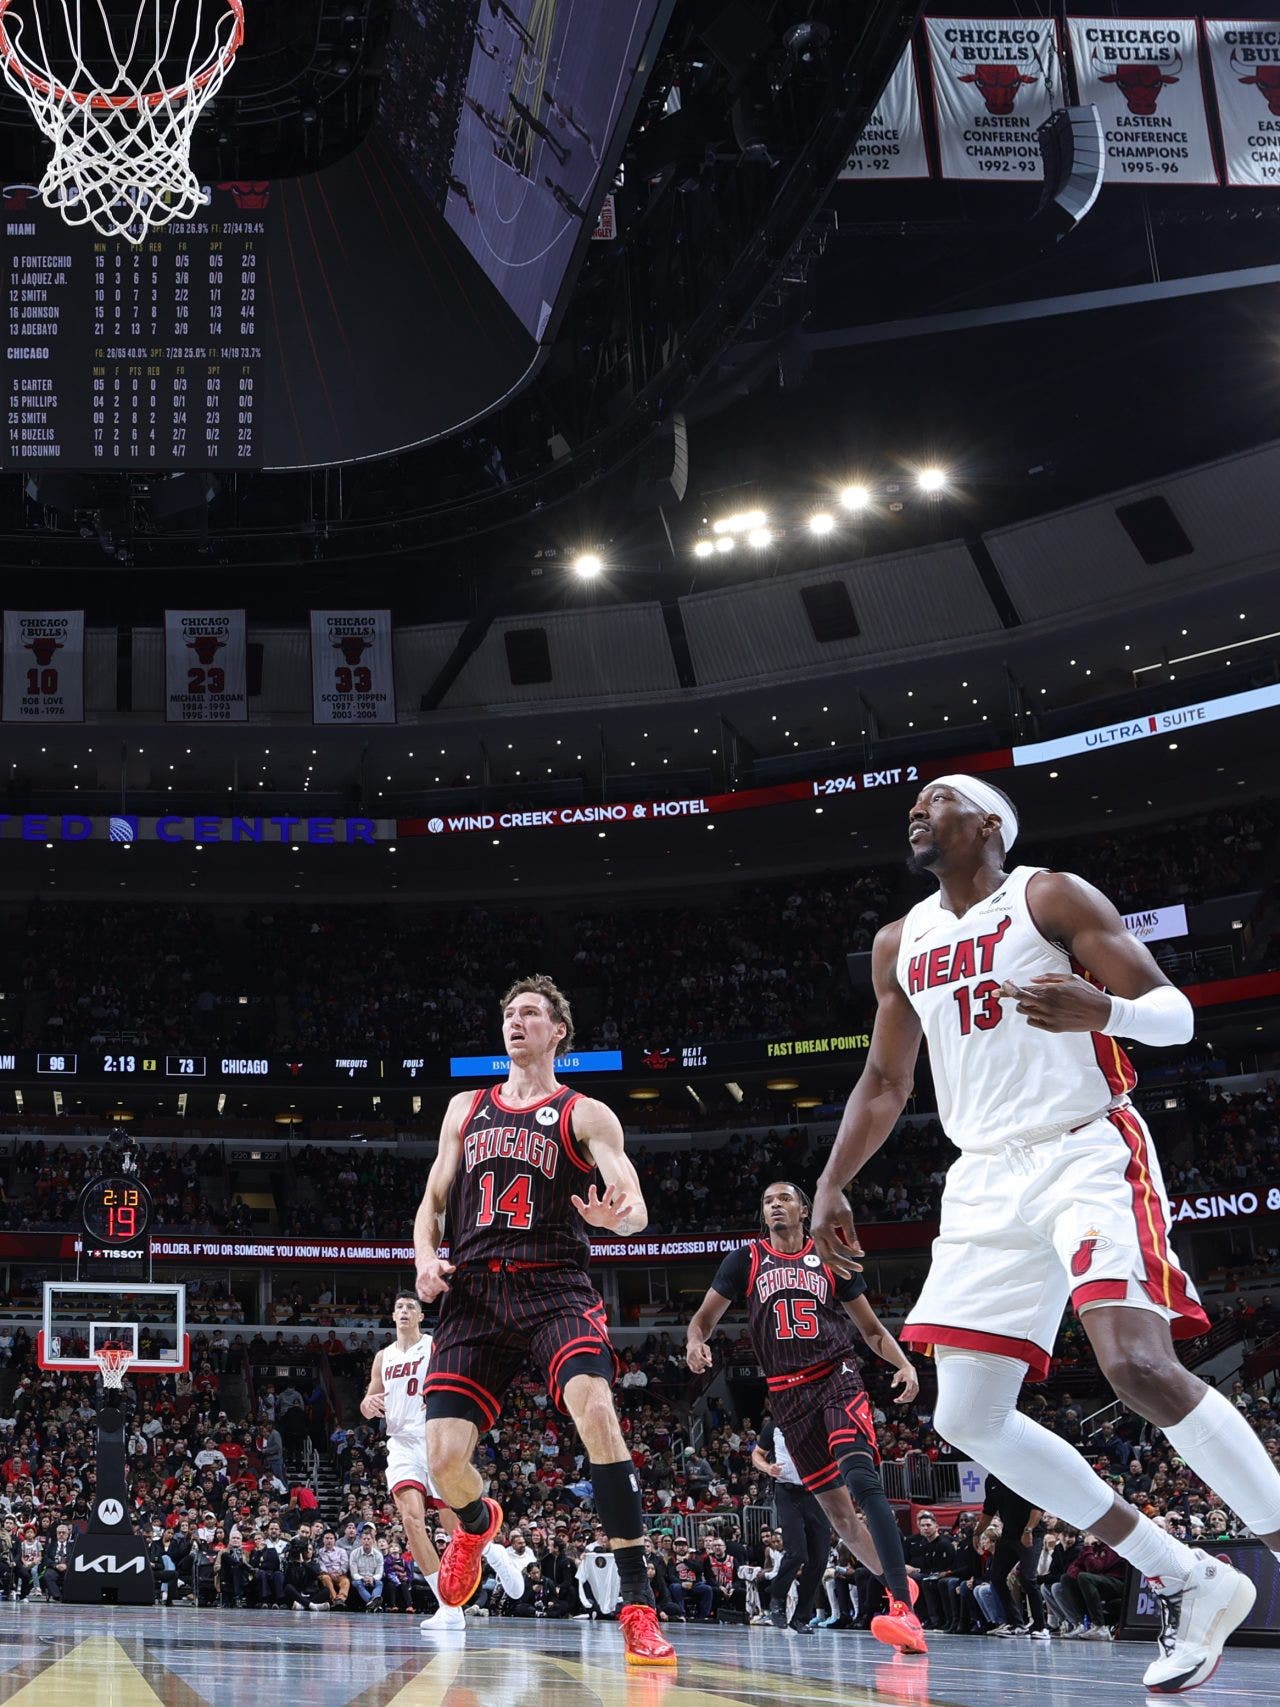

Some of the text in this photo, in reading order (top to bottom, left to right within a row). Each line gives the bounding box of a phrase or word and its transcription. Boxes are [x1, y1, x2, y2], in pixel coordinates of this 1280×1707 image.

[945, 29, 1040, 45] CHICAGO
[1086, 29, 1180, 45] CHICAGO
[962, 47, 1029, 61] BULLS
[1104, 48, 1170, 61] BULLS
[975, 117, 1029, 127] EASTERN
[1116, 116, 1172, 128] EASTERN
[1105, 132, 1188, 143] CONFERENCE
[1108, 145, 1189, 158] CHAMPIONS
[7, 223, 36, 236] MIAMI
[21, 256, 72, 268] FONTECCHIO
[21, 273, 67, 286] JAQUEZ JR.
[10, 290, 47, 301] 12 SMITH
[9, 307, 59, 318] 16 JOHNSON
[10, 323, 58, 335] 13 ADEBAYO
[7, 348, 49, 359] CHICAGO
[21, 379, 52, 391] CARTER
[10, 396, 58, 407] 15 PHILLIPS
[8, 412, 47, 424] 25 SMITH
[10, 429, 54, 440] 14 BUZELIS
[21, 445, 60, 457] DOSUNMU
[20, 618, 68, 627] CHICAGO
[181, 618, 229, 626] CHICAGO
[327, 618, 375, 626] CHICAGO
[27, 628, 61, 637] BULLS
[189, 627, 223, 635] BULLS
[27, 669, 58, 695] 10
[187, 668, 225, 694] 23
[335, 667, 372, 693] 33
[23, 697, 63, 705] BOB LOVE
[171, 694, 244, 702] MICHAEL JORDAN
[322, 694, 387, 702] SCOTTIE PIPPEN
[1085, 707, 1207, 747] ULTRA SUITE
[813, 766, 918, 796] I-294 EXIT 2
[448, 815, 494, 832] WIND
[560, 806, 627, 824] CASINO
[633, 804, 647, 819] &
[652, 800, 709, 817] HOTEL
[155, 815, 376, 844] CENTER
[908, 915, 1012, 996] HEAT
[953, 979, 1003, 1036] 13
[767, 1034, 869, 1056] FAST BREAK POINTS
[682, 1047, 702, 1058] HEAT
[50, 1057, 64, 1070] 96
[104, 1056, 135, 1072] 2:13
[179, 1059, 194, 1073] 73
[221, 1059, 268, 1074] CHICAGO
[335, 1059, 368, 1068] TIMEOUTS
[402, 1059, 424, 1068] FOULS
[682, 1056, 707, 1067] BULLS
[348, 1068, 354, 1077] 4
[411, 1068, 416, 1077] 5
[464, 1127, 558, 1179] CHICAGO
[104, 1190, 138, 1205] 2:13
[476, 1172, 533, 1229] 14
[109, 1207, 136, 1236] 19
[103, 1250, 144, 1258] TISSOT
[151, 1243, 390, 1258] OR OLDER. IF YOU OR SOMEONE YOU KNOW HAS A GAMBLING
[590, 1241, 718, 1256] ERVICES CAN BE ACCESSED BY
[756, 1268, 828, 1304] CHICAGO
[773, 1298, 819, 1339] 15
[385, 1356, 425, 1381] HEAT
[407, 1378, 419, 1396] 0
